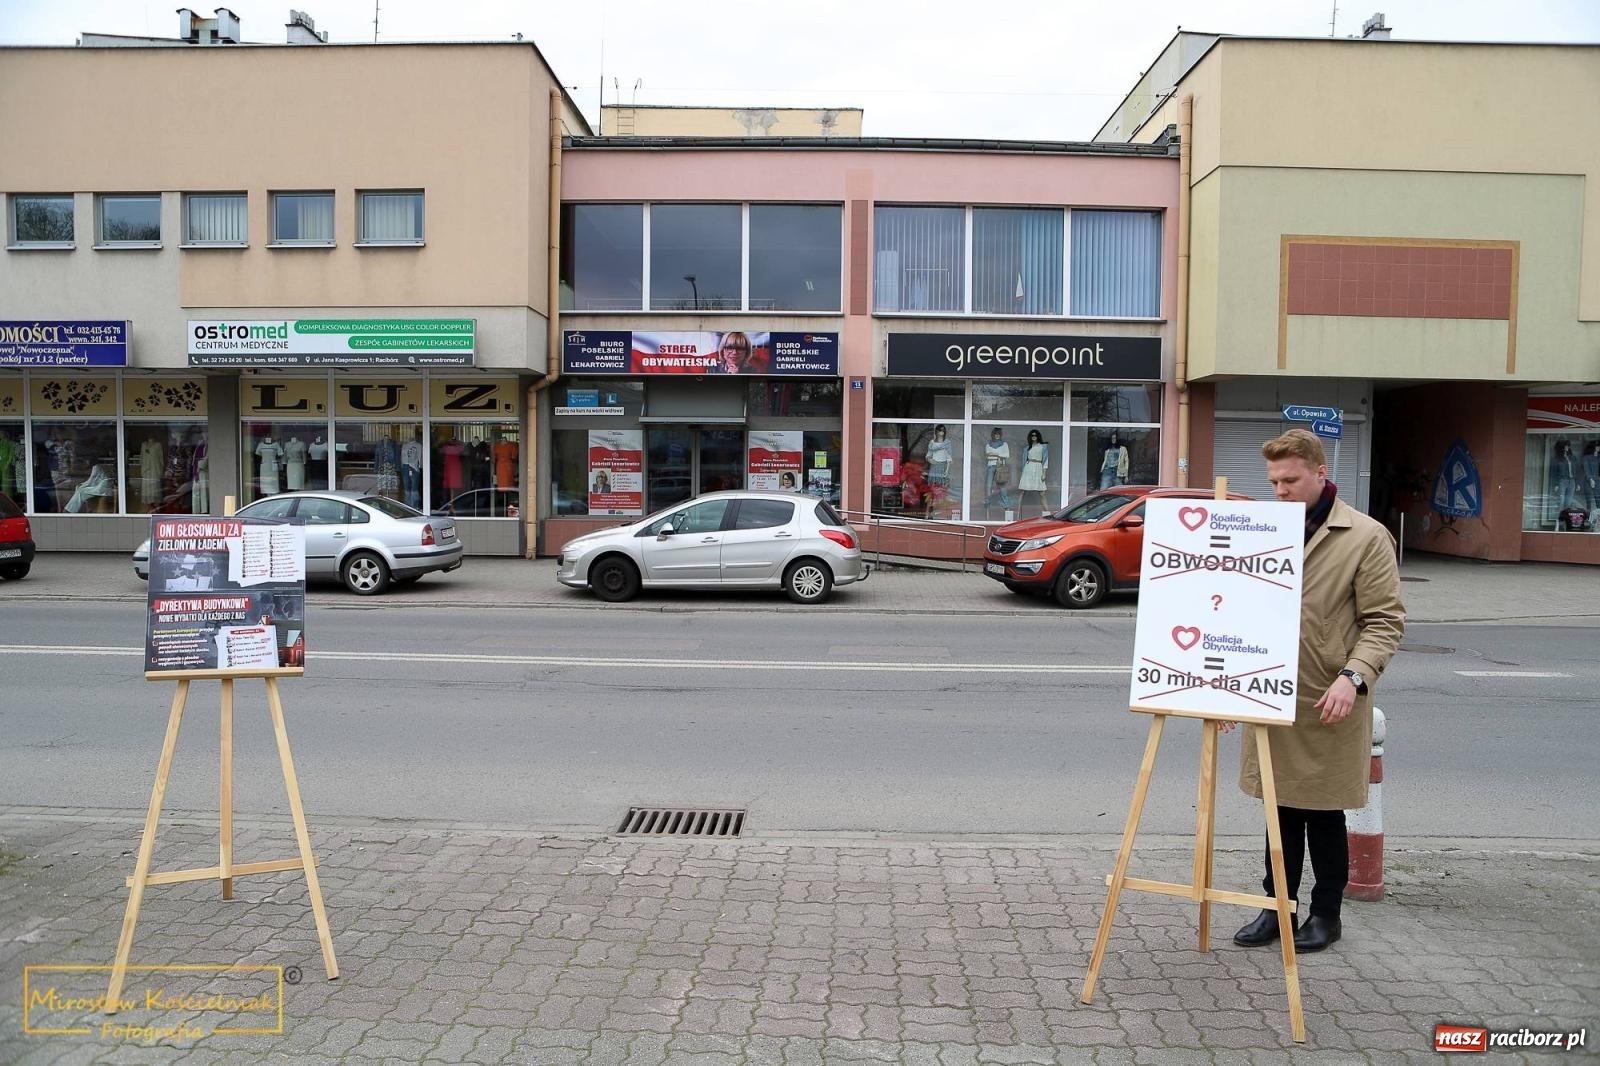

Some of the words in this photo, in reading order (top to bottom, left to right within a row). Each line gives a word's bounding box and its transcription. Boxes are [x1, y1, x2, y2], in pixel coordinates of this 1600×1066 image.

[194, 322, 288, 339] ostromed
[195, 341, 238, 349] CENTRUM
[241, 341, 289, 349] MEDYCZNE
[660, 345, 697, 354] STREFA
[776, 348, 820, 356] POSELSKIE
[945, 343, 1104, 372] greenpoint
[56, 355, 88, 364] (parter)
[642, 358, 718, 367] OBYWATELSKA
[251, 384, 326, 413] L.
[340, 384, 418, 413] U.
[444, 384, 513, 413] Z.
[1301, 410, 1327, 418] Opawska
[1210, 513, 1251, 524] Koalicja
[160, 524, 176, 538] ONI
[177, 524, 226, 537] GŁOSOWALI
[228, 524, 240, 536] ZA
[1210, 521, 1277, 533] Obywatelska
[158, 540, 196, 551] ZIELONYM
[1150, 552, 1295, 575] OBWODNICA
[1211, 594, 1223, 611] ?
[158, 614, 174, 622] NOWE
[174, 614, 196, 622] WYDATKI
[198, 613, 207, 621] DLA
[208, 611, 230, 620] KAŻDEGO
[236, 612, 246, 620] NAS
[1203, 633, 1243, 645] Koalicja
[1202, 641, 1268, 654] Obywatelska
[1137, 668, 1161, 684] 30
[1210, 674, 1241, 692] dla
[1248, 677, 1294, 696] ANS
